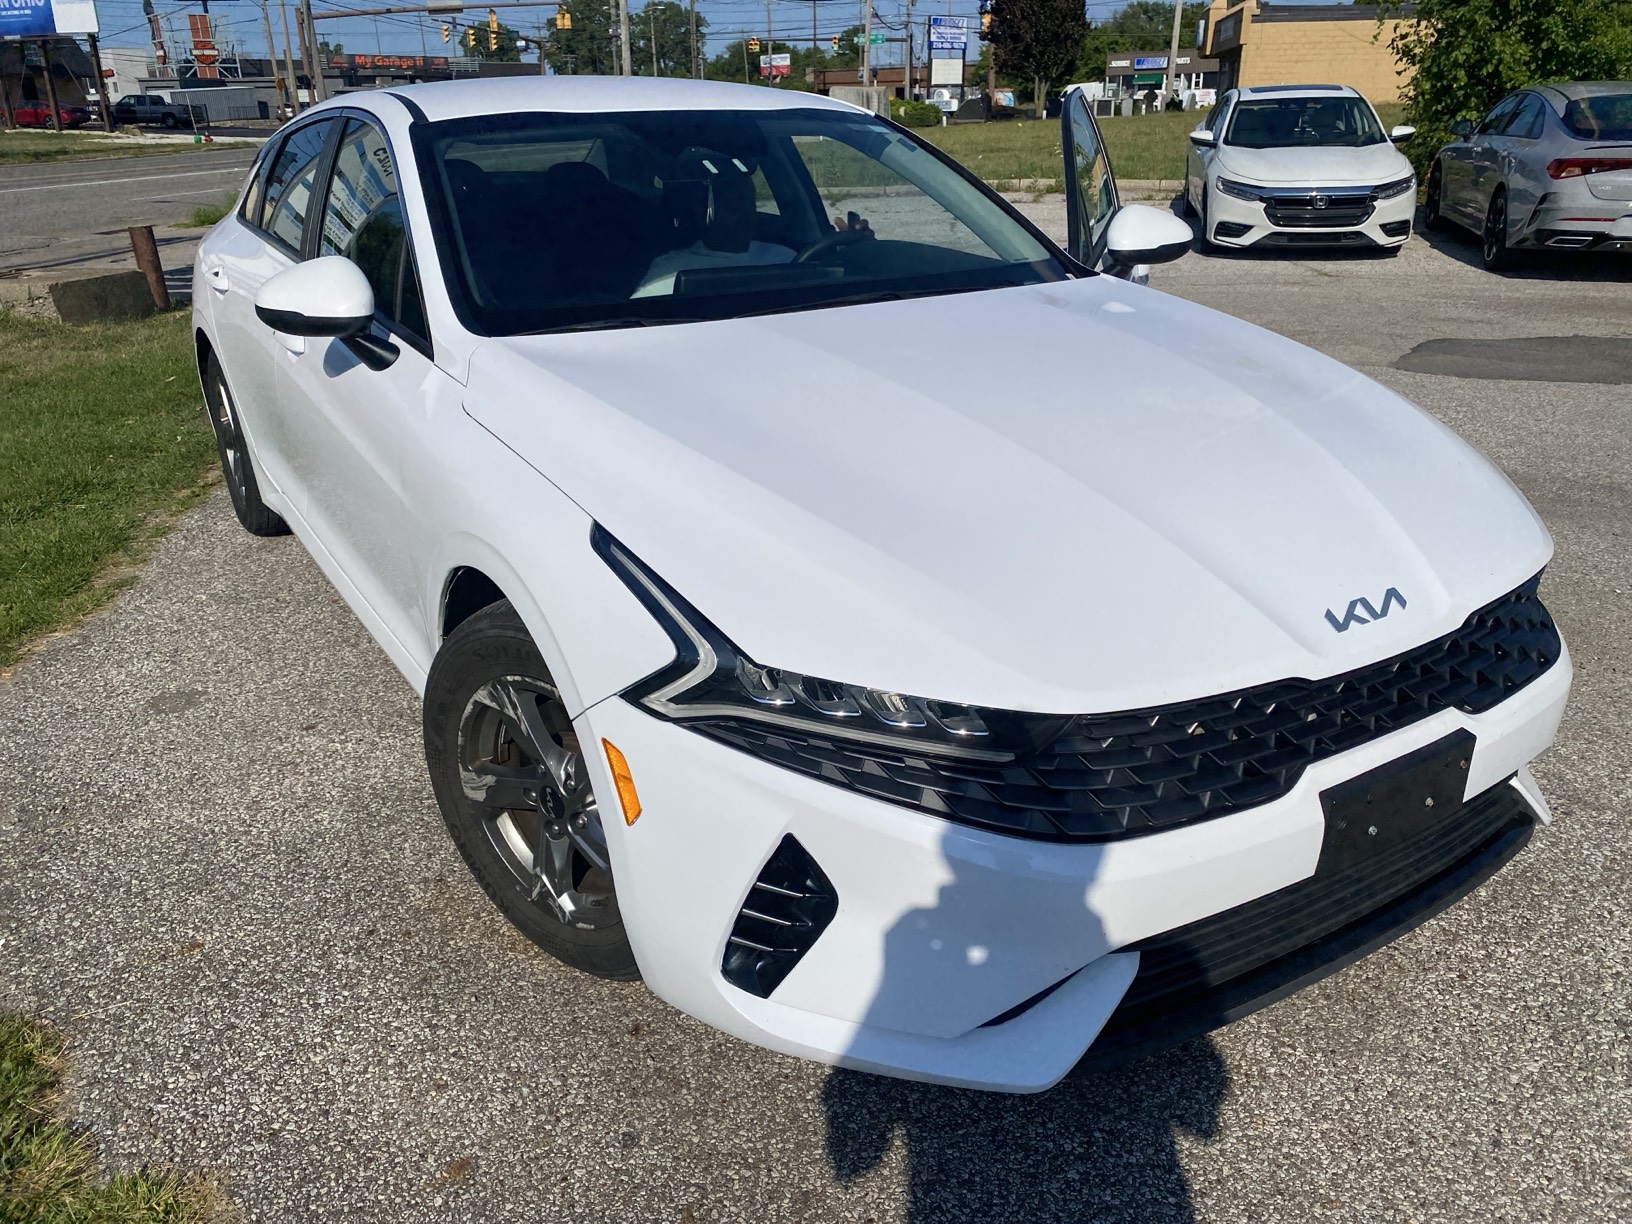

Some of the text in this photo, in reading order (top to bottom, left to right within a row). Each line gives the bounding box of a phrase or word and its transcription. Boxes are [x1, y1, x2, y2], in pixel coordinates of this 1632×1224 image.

[355, 55, 371, 67] My
[375, 56, 414, 68] Garage
[1324, 587, 1407, 633] KIA
